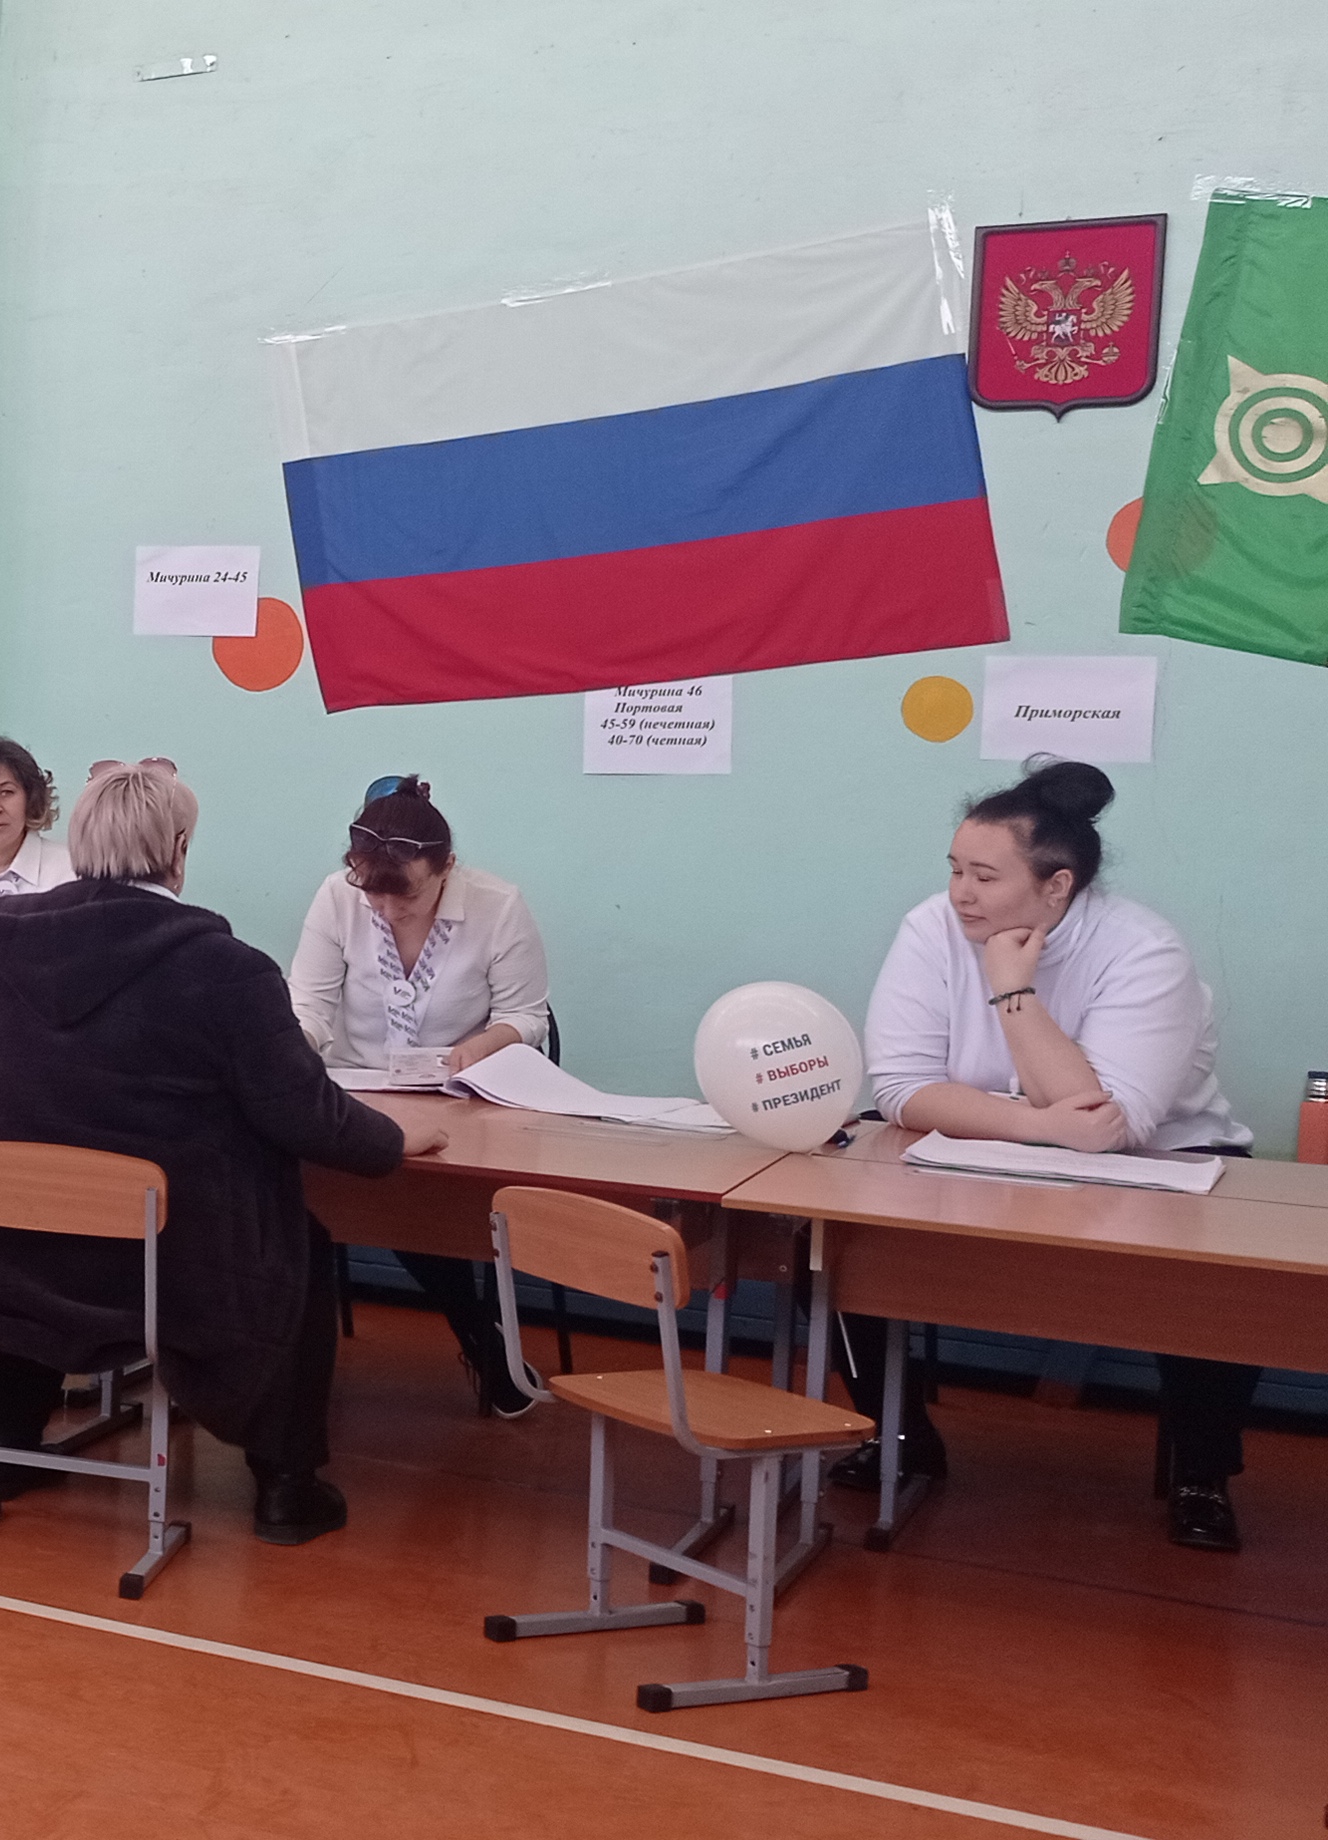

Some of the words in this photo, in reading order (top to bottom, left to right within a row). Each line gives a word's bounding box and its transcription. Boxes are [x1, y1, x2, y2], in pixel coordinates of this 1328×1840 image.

[146, 571, 211, 585] Мичурина
[213, 571, 248, 583] 24-45
[614, 686, 683, 700] Мичурина
[687, 685, 703, 697] 46
[614, 702, 683, 716] Портовая
[1014, 705, 1121, 722] Приморская
[600, 718, 636, 730] 45-59
[639, 718, 716, 731] (нечетная)
[607, 735, 644, 746] 40-70
[646, 735, 708, 748] (четная)
[762, 1033, 812, 1057] СЕМЬЯ
[767, 1055, 829, 1081] ВЫБОРЫ
[761, 1078, 841, 1111] ПРЕЗИДЕНТ
